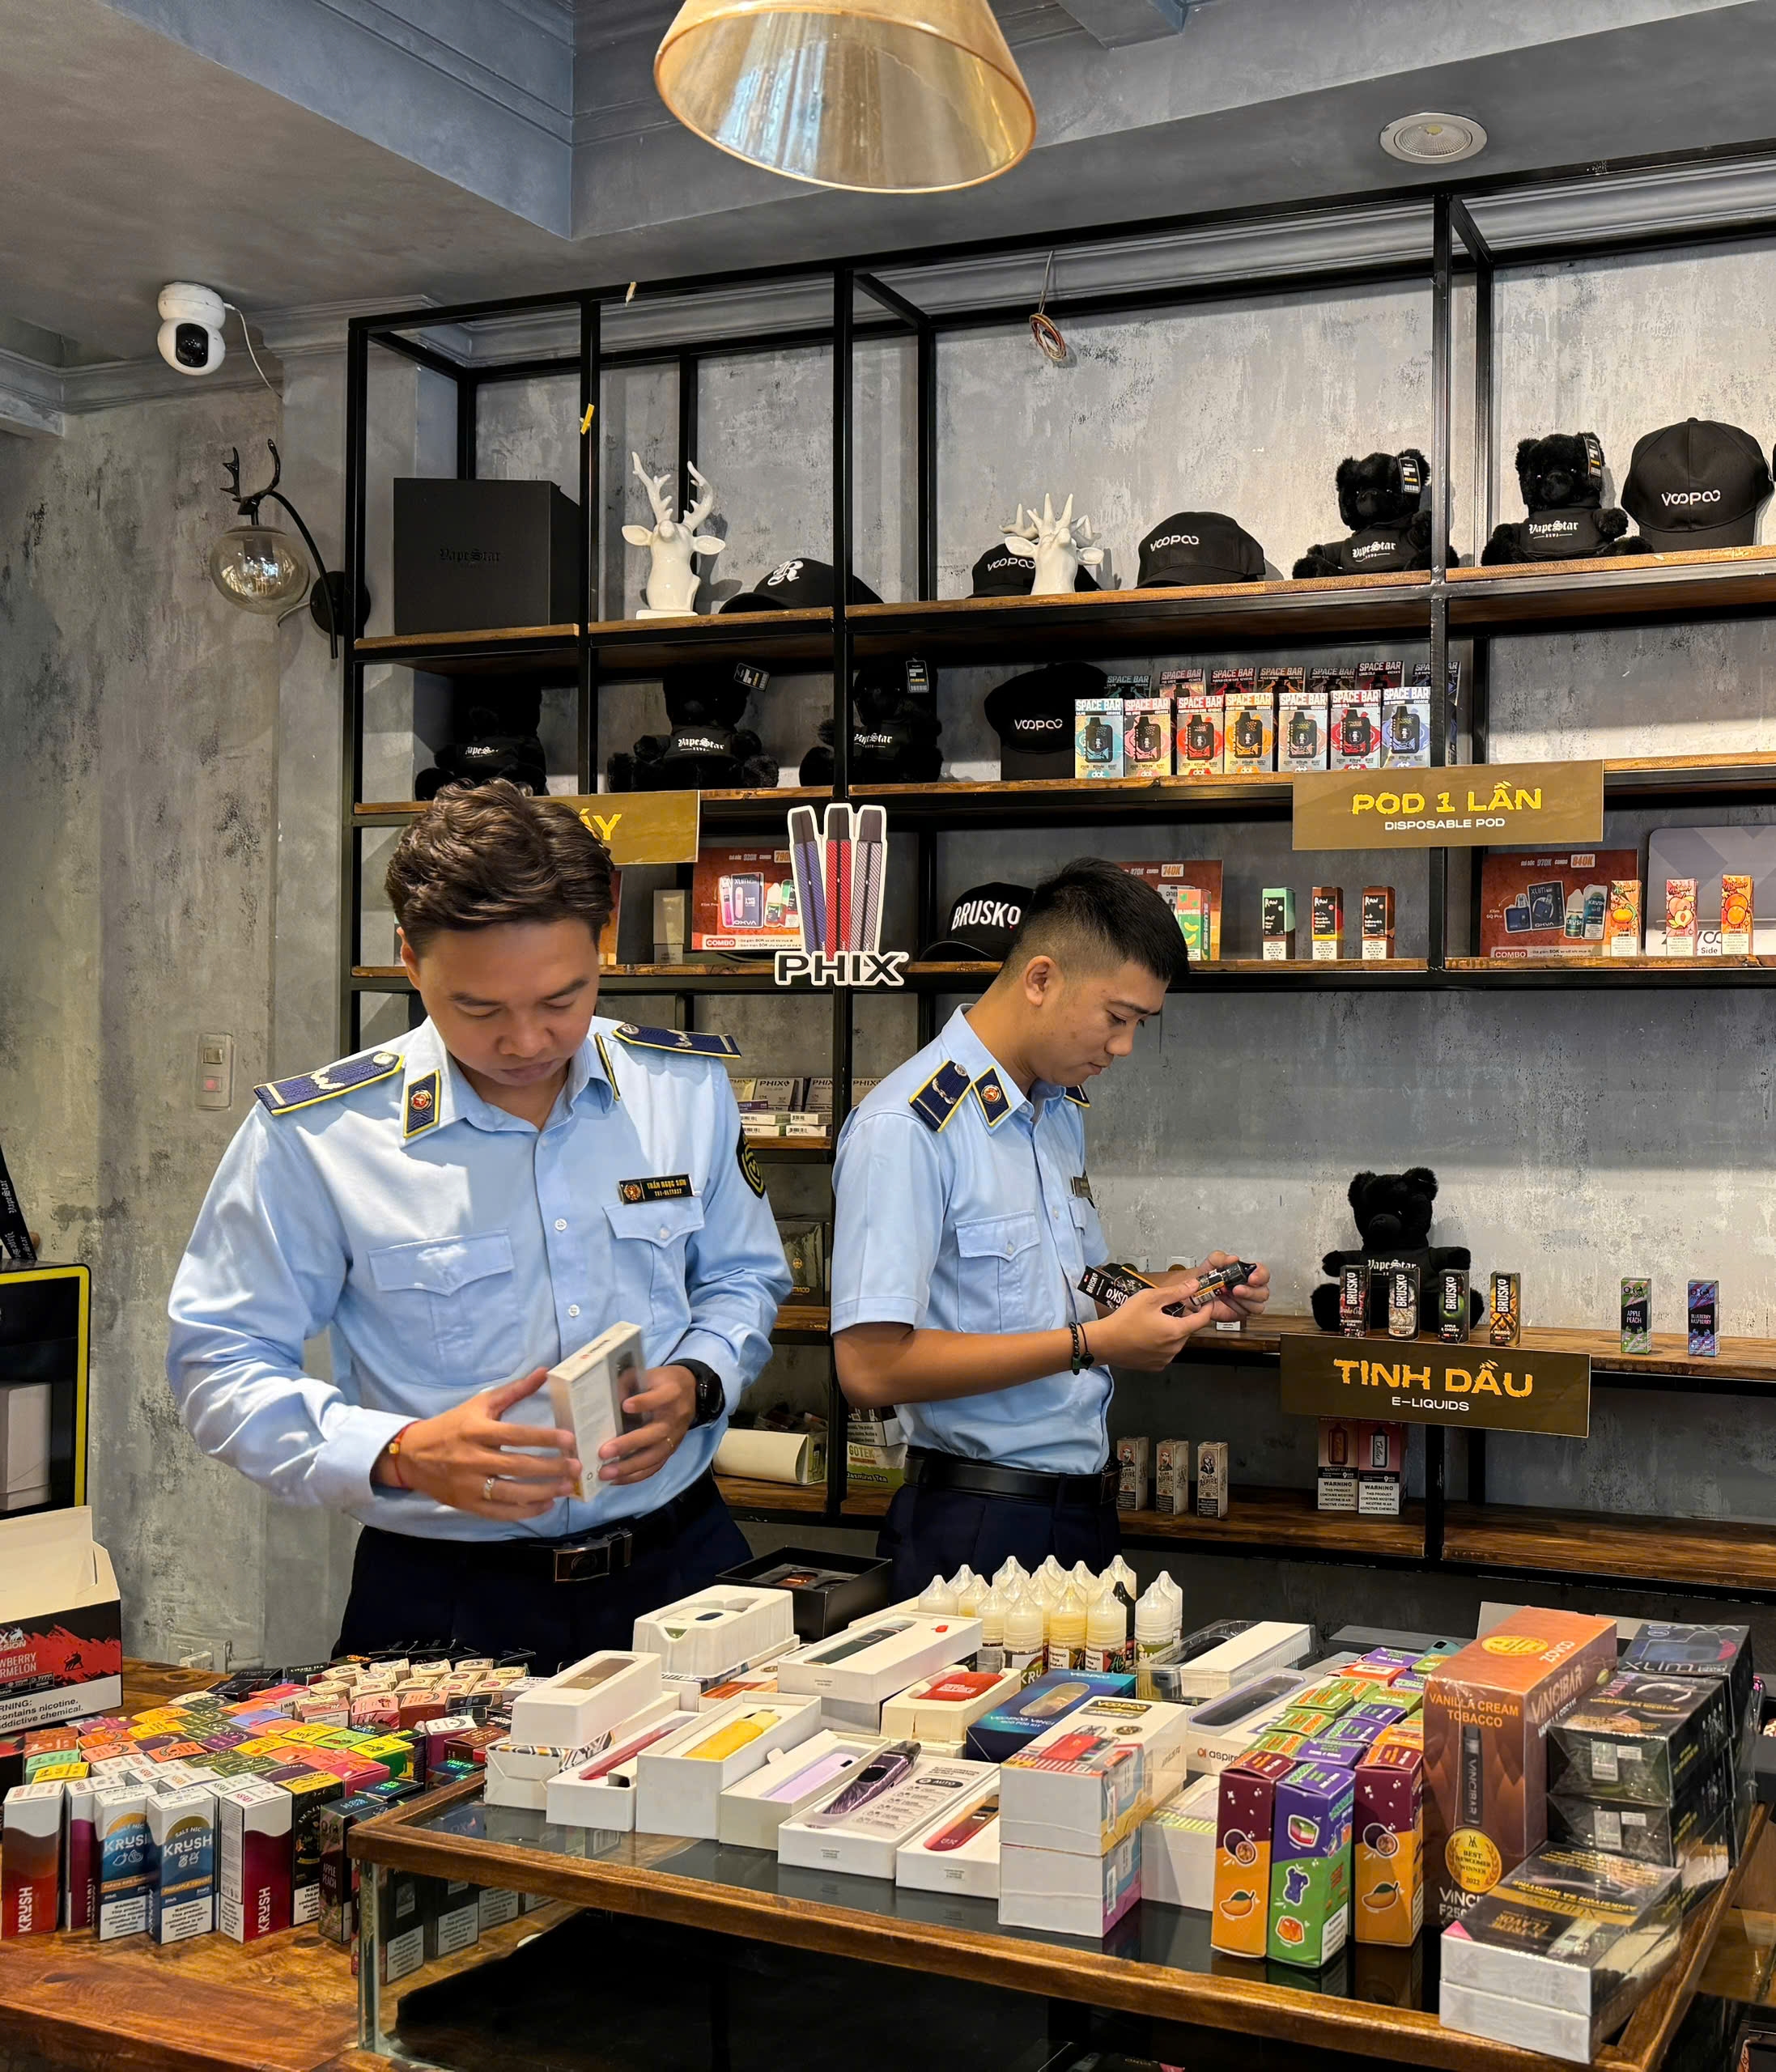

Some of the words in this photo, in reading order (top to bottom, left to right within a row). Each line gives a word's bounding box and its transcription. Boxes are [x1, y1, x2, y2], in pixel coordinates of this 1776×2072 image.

[1661, 490, 1720, 507] VOOPOO
[1528, 520, 1578, 536] VapeStar
[1150, 534, 1199, 553] VOOPOO
[1352, 540, 1396, 559] VapeStar
[1213, 669, 1237, 679] SPACE
[1238, 668, 1254, 677] BAR
[1260, 667, 1285, 677] SPACE
[1286, 666, 1302, 676] BAR
[1312, 668, 1336, 677] SPACE
[1337, 668, 1355, 677] BAR
[1359, 662, 1384, 672] SPACE
[1385, 660, 1402, 670] BAR
[1415, 663, 1430, 672] SPA
[1107, 675, 1132, 684] SPACE
[1133, 675, 1149, 683] BAR
[1162, 670, 1187, 681] SPACE
[1188, 669, 1203, 678] BAR
[1226, 694, 1251, 706] SPACE
[1254, 694, 1272, 705] BAR
[1280, 694, 1304, 706] SPACE
[1308, 693, 1327, 705] BAR
[1332, 691, 1357, 703] SPACE
[1360, 690, 1380, 703] BAR
[1383, 689, 1409, 700] SPACE
[1411, 687, 1430, 699] BAR
[1076, 699, 1102, 711] SPACE
[1104, 698, 1122, 711] BAR
[1126, 699, 1149, 711] SPACE
[1152, 698, 1168, 710] BAR
[1178, 697, 1204, 708] SPACE
[1205, 696, 1222, 707] BAR
[1014, 719, 1063, 732] VOOPOO
[678, 737, 725, 750] VapeStar
[1351, 791, 1425, 814] POD
[1436, 792, 1455, 813] 1
[1467, 780, 1542, 812] LẦN
[1385, 819, 1472, 830] DISPOSABLE
[1476, 817, 1506, 828] POD
[952, 898, 1022, 930] BRUSKO
[1495, 950, 1527, 958] COMBO
[778, 954, 900, 982] PHIX
[1346, 1272, 1358, 1305] BRUSKO
[1396, 1274, 1408, 1307] BRUSKO
[1445, 1276, 1457, 1310] BRUSKO
[1497, 1279, 1509, 1313] BRUSKO
[1333, 1358, 1431, 1391] TINH
[1444, 1358, 1533, 1399] DẦU
[1391, 1396, 1470, 1412] E-LIQUIDS
[848, 1445, 875, 1458] GOTEK
[0, 1652, 36, 1668] WBERRY
[1540, 1641, 1576, 1663] ZOVOO
[0, 1662, 36, 1678] RMELON
[1621, 1661, 1693, 1672] XLIM
[1021, 1668, 1043, 1685] KRU
[1531, 1664, 1583, 1725] VINCIBAR
[0, 1699, 32, 1712] RNING:
[39, 1699, 79, 1712] nicotine.
[1429, 1693, 1476, 1707] VANILLA
[1477, 1700, 1519, 1717] CREAM
[0, 1716, 38, 1730] ddictive
[40, 1705, 83, 1721] chemical.
[1447, 1709, 1503, 1728] TOBACCO
[1468, 1759, 1477, 1815] VINCIBAR
[104, 1833, 148, 1852] KRUS
[164, 1833, 213, 1858] KRUSH
[1463, 1850, 1483, 1860] BEST
[1459, 1864, 1487, 1875] WINNER
[1466, 1877, 1481, 1886] 2022
[18, 1887, 33, 1933] KRUSH
[258, 1886, 271, 1933] KRUSH
